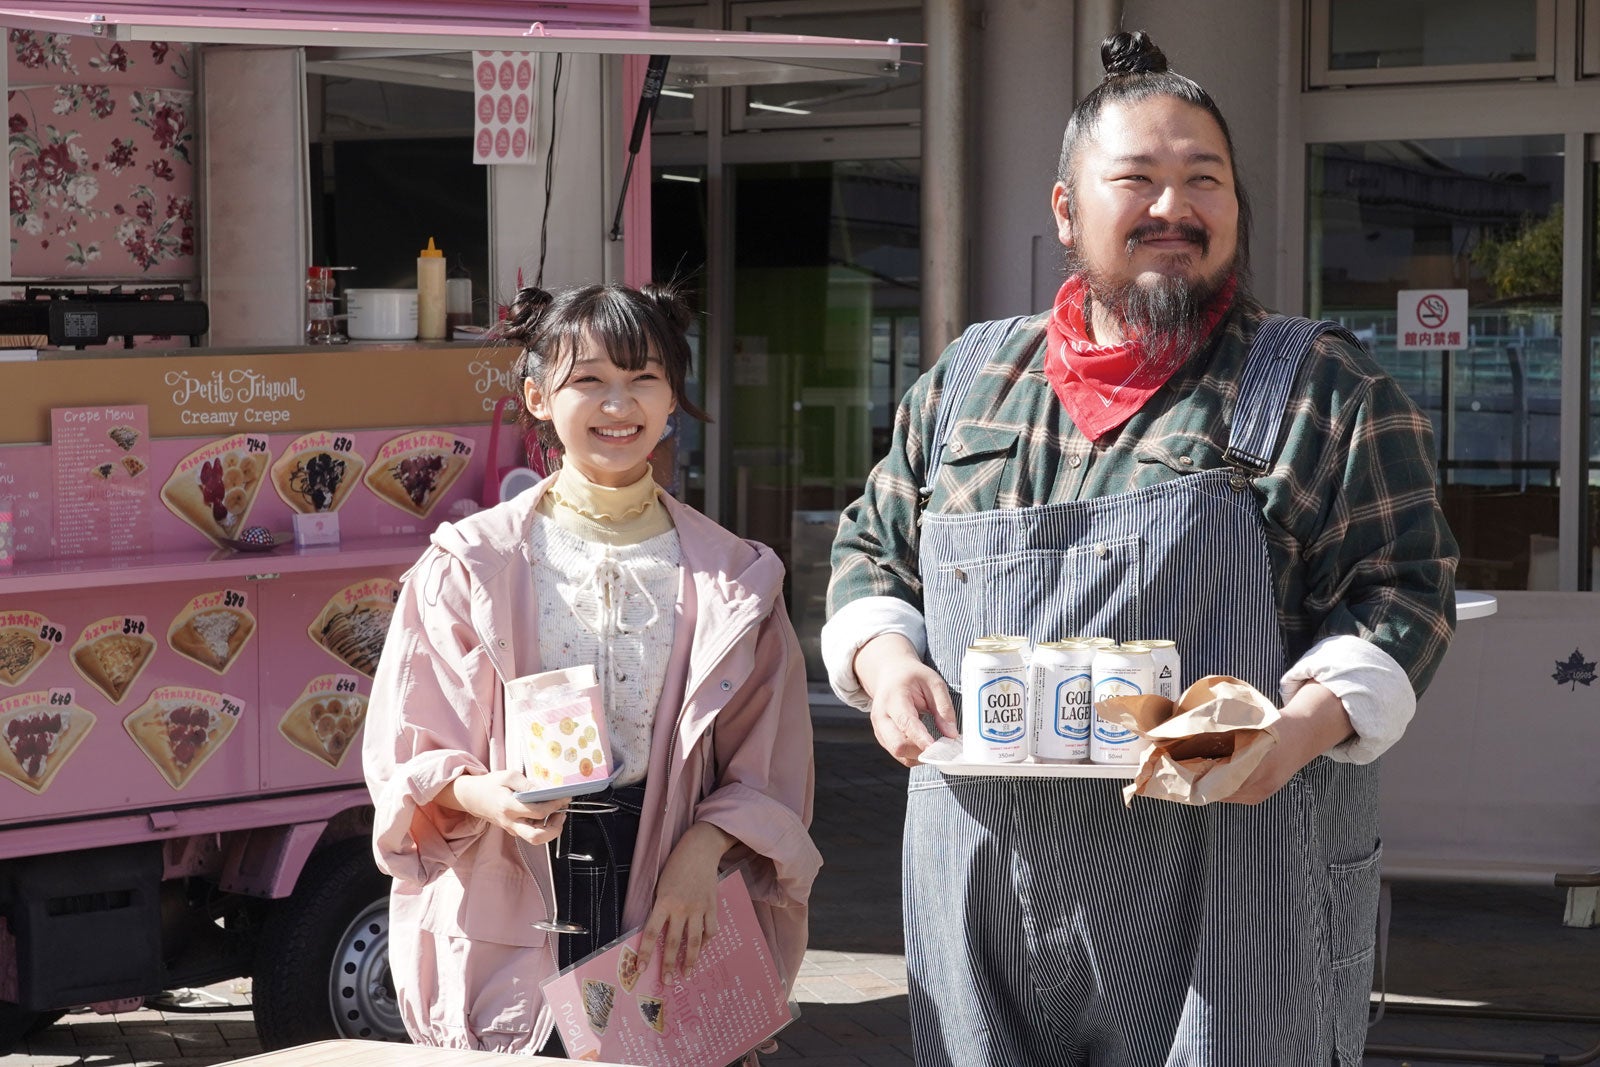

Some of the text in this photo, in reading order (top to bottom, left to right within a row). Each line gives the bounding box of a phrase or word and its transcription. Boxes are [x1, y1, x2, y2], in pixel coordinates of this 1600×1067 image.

[1405, 332, 1460, 346] 館内禁煙
[165, 369, 306, 406] Petit Trianon
[64, 408, 134, 423] Crepe Menu
[181, 408, 290, 426] Creamy Crepe
[246, 438, 266, 452] 740
[334, 437, 352, 452] 690
[452, 440, 472, 455] 740
[40, 625, 62, 642] 590
[123, 618, 144, 634] 540
[336, 678, 356, 692] 640
[50, 692, 72, 706] 640
[988, 693, 1020, 708] GOLD
[220, 698, 240, 716] 740
[984, 708, 1024, 724] LAGER
[561, 1000, 586, 1052] Menu
